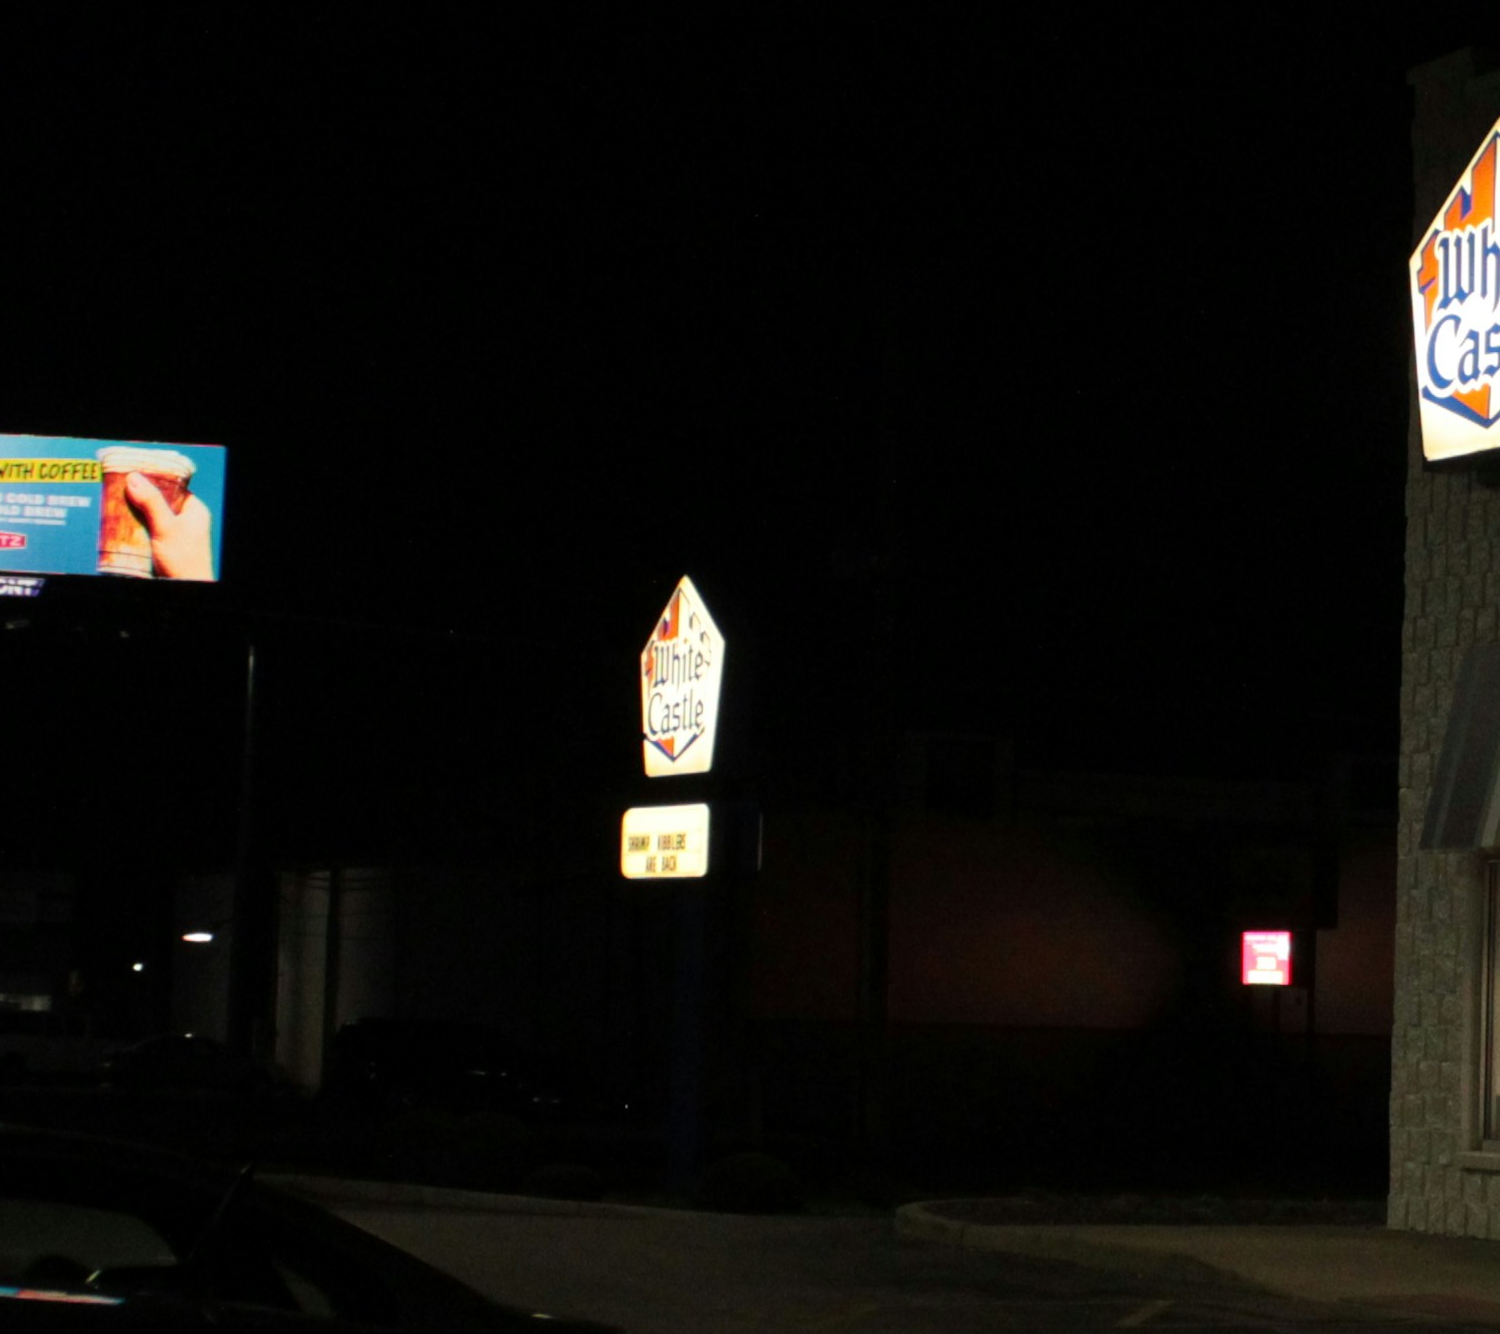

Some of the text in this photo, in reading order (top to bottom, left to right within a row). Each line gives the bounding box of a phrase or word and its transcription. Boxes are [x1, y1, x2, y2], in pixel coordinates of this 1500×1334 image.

[39, 463, 98, 480] COFFEE
[5, 492, 44, 504] COLD
[47, 495, 92, 507] BREW
[24, 505, 67, 518] BREW
[652, 637, 704, 691] White
[647, 688, 704, 736] Castle
